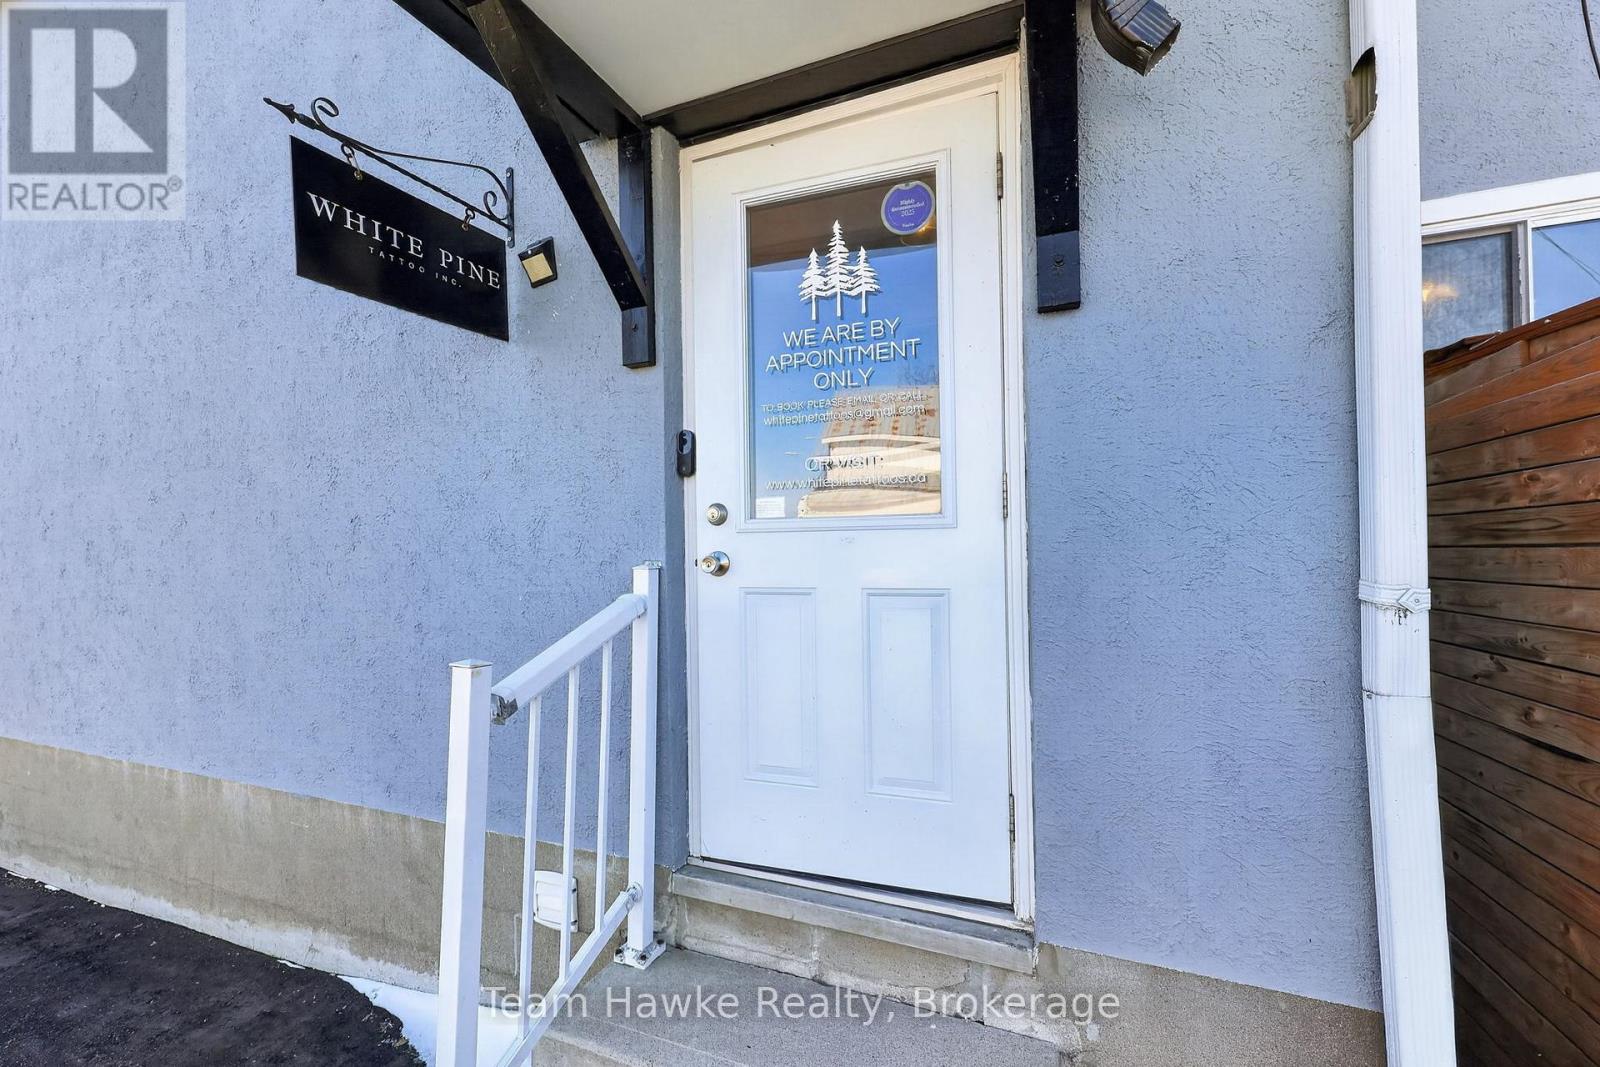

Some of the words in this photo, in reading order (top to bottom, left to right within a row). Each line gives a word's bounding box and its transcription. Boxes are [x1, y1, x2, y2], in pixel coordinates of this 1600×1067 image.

[306, 191, 424, 258] WHITE
[438, 247, 501, 289] PINE
[368, 246, 426, 274] TATTOO
[435, 272, 463, 288] INC.
[782, 328, 817, 348] WE
[821, 322, 865, 344] ARE
[870, 317, 901, 338] BY
[765, 338, 921, 372] APPOINTMENT
[813, 367, 874, 390] ONLY
[760, 403, 774, 412] TO
[777, 401, 804, 411] BOOK
[807, 397, 844, 409] PLEASE
[847, 394, 874, 405] EMAIL
